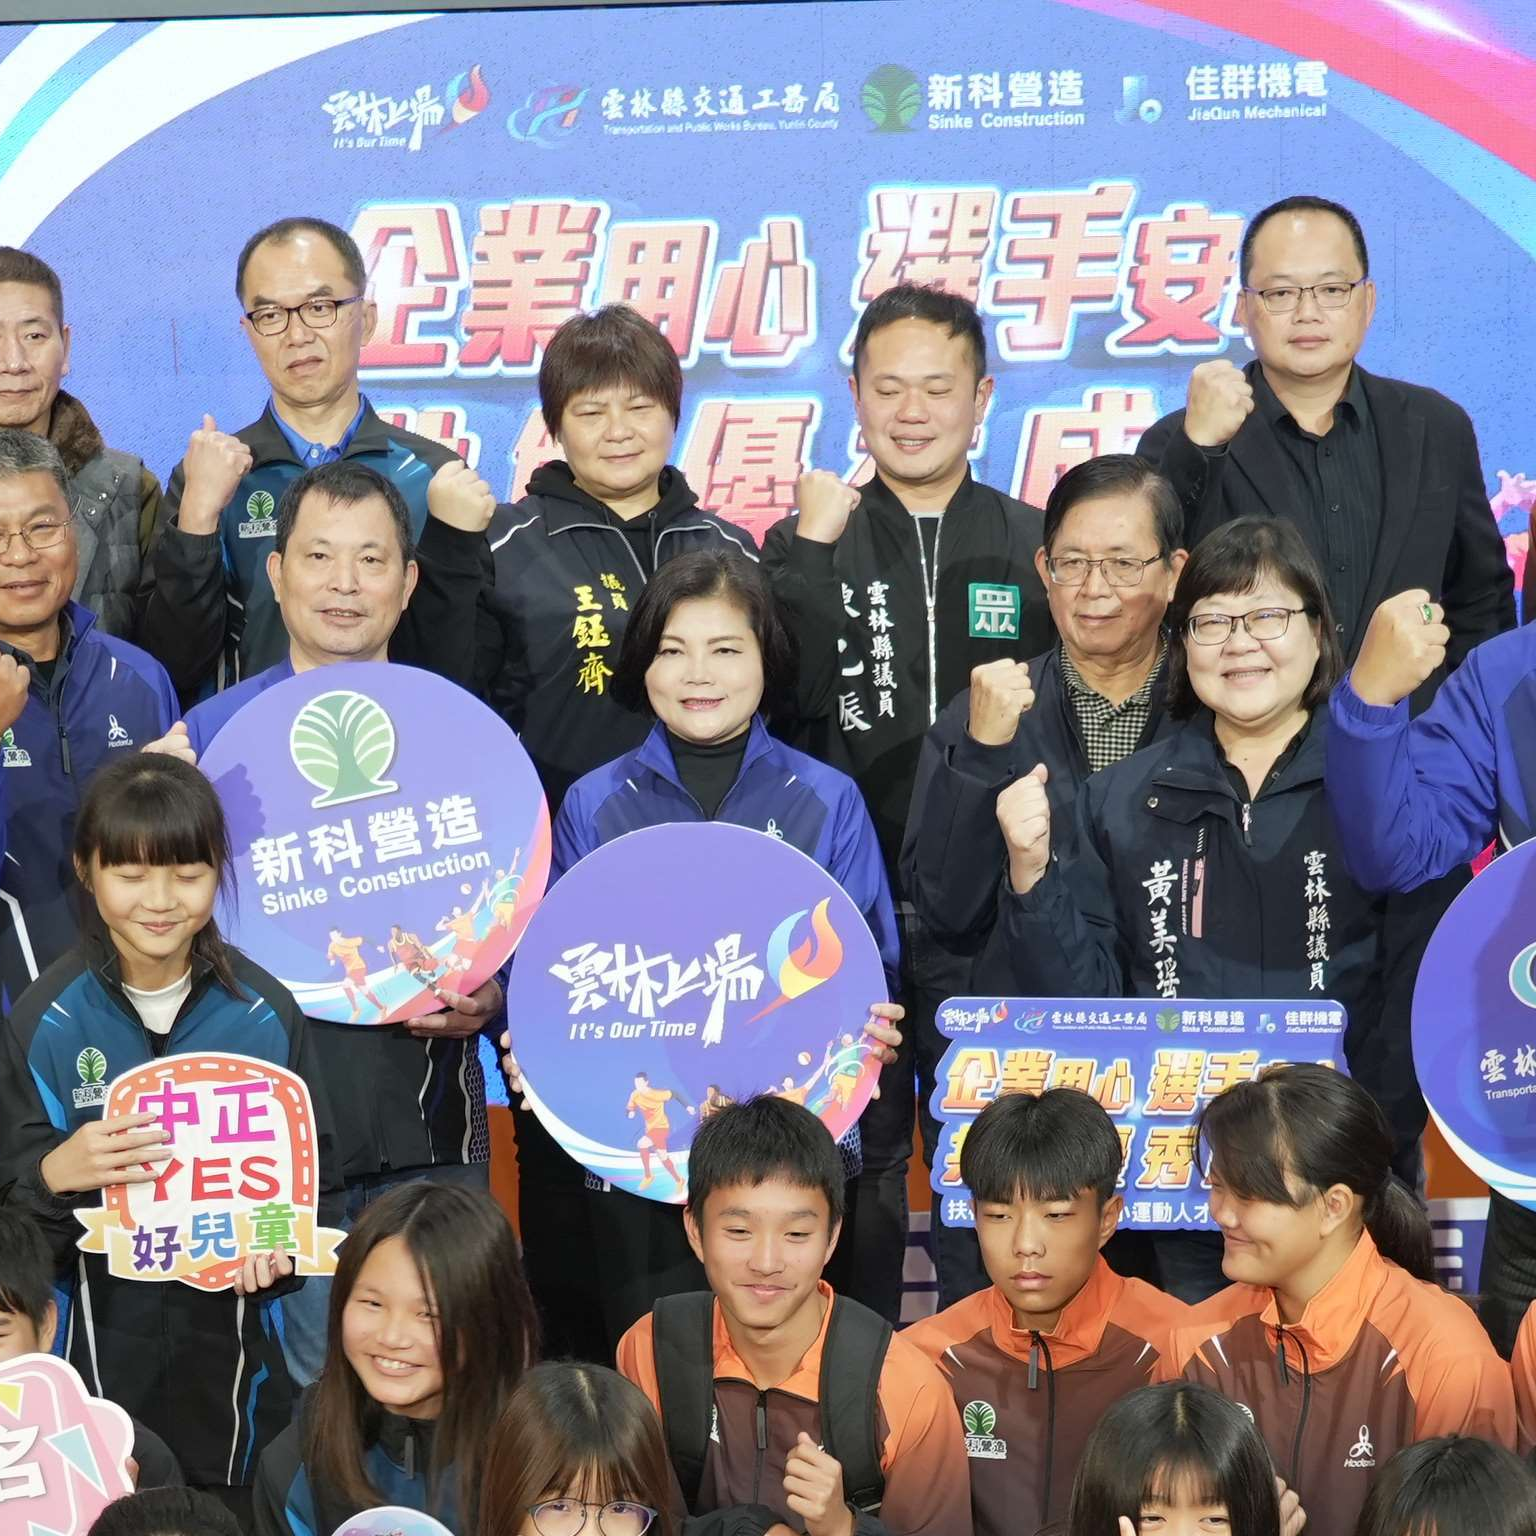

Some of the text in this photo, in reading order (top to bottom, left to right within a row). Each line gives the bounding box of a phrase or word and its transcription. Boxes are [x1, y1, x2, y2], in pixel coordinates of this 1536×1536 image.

[928, 70, 1084, 111] 新科營造
[1186, 62, 1328, 101] 佳群機電
[928, 110, 1085, 129] Sinke Construction
[1244, 104, 1326, 119] Mechanical
[867, 581, 898, 718] 雲林縣議員
[251, 794, 483, 888] 新科營造
[261, 851, 492, 916] Sinke Construction
[1303, 851, 1333, 991] 雲林縣議員
[548, 933, 765, 1049] 雲林上場
[569, 1019, 697, 1041] It's Our Time
[1181, 1010, 1244, 1026] 新科營造
[141, 1156, 281, 1202] YES
[131, 1201, 297, 1273] 好兒童
